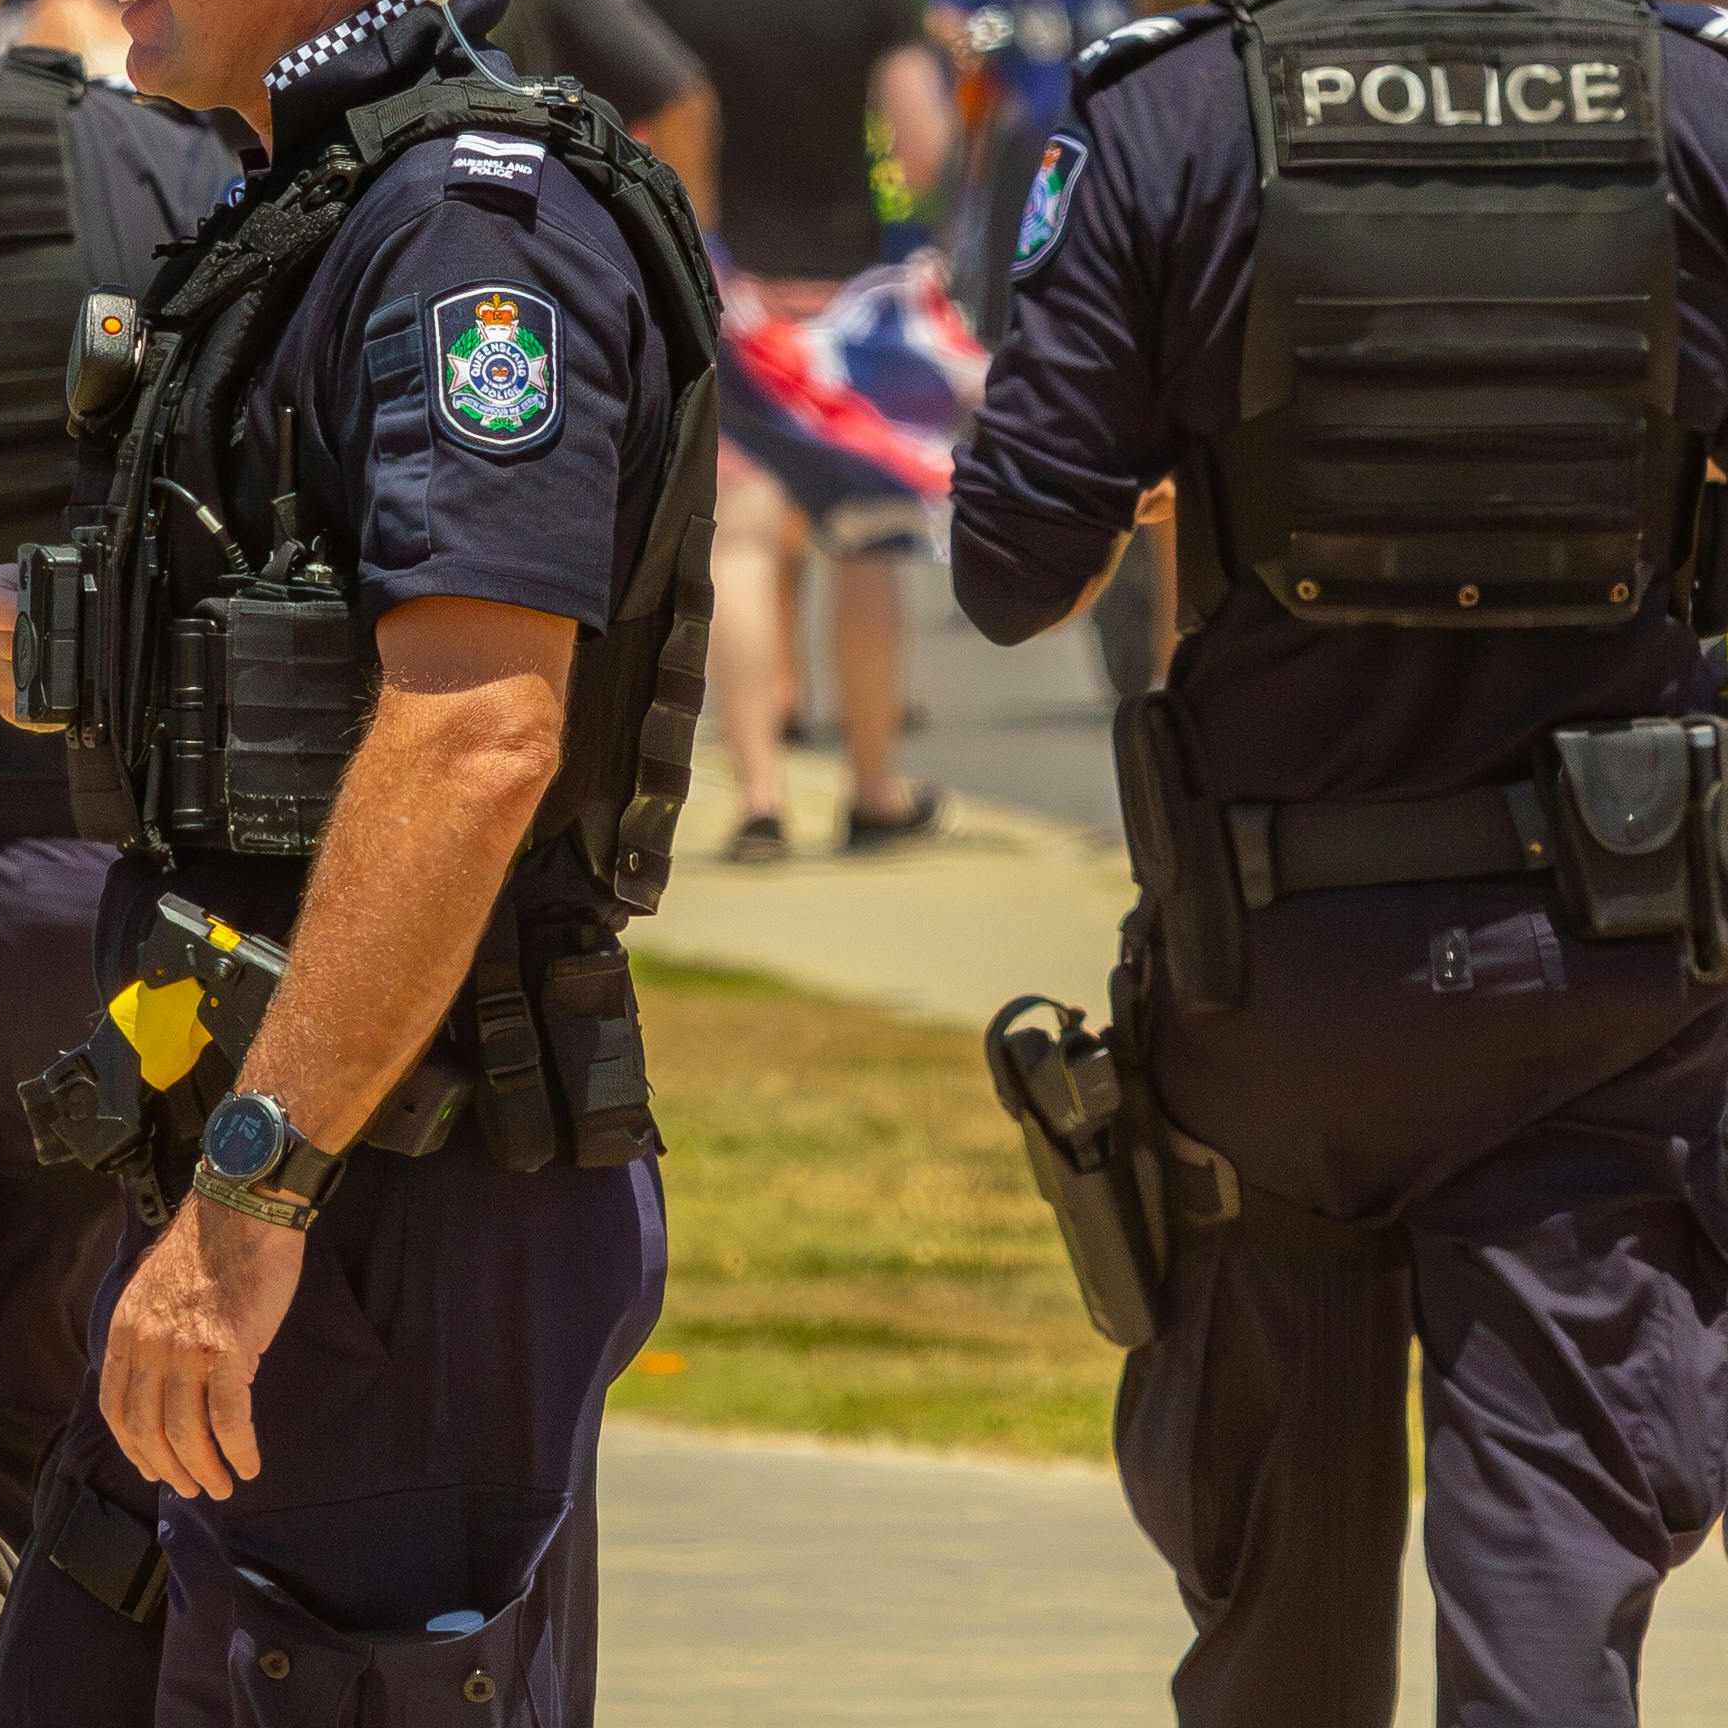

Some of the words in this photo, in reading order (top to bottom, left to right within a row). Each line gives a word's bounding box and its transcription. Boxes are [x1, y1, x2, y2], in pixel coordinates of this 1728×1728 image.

[1301, 62, 1627, 128] POLICE
[453, 158, 533, 175] QUEENSLAND
[468, 166, 514, 180] POLICE
[471, 342, 527, 378] QUEENSLAND
[480, 384, 522, 400] POLICE
